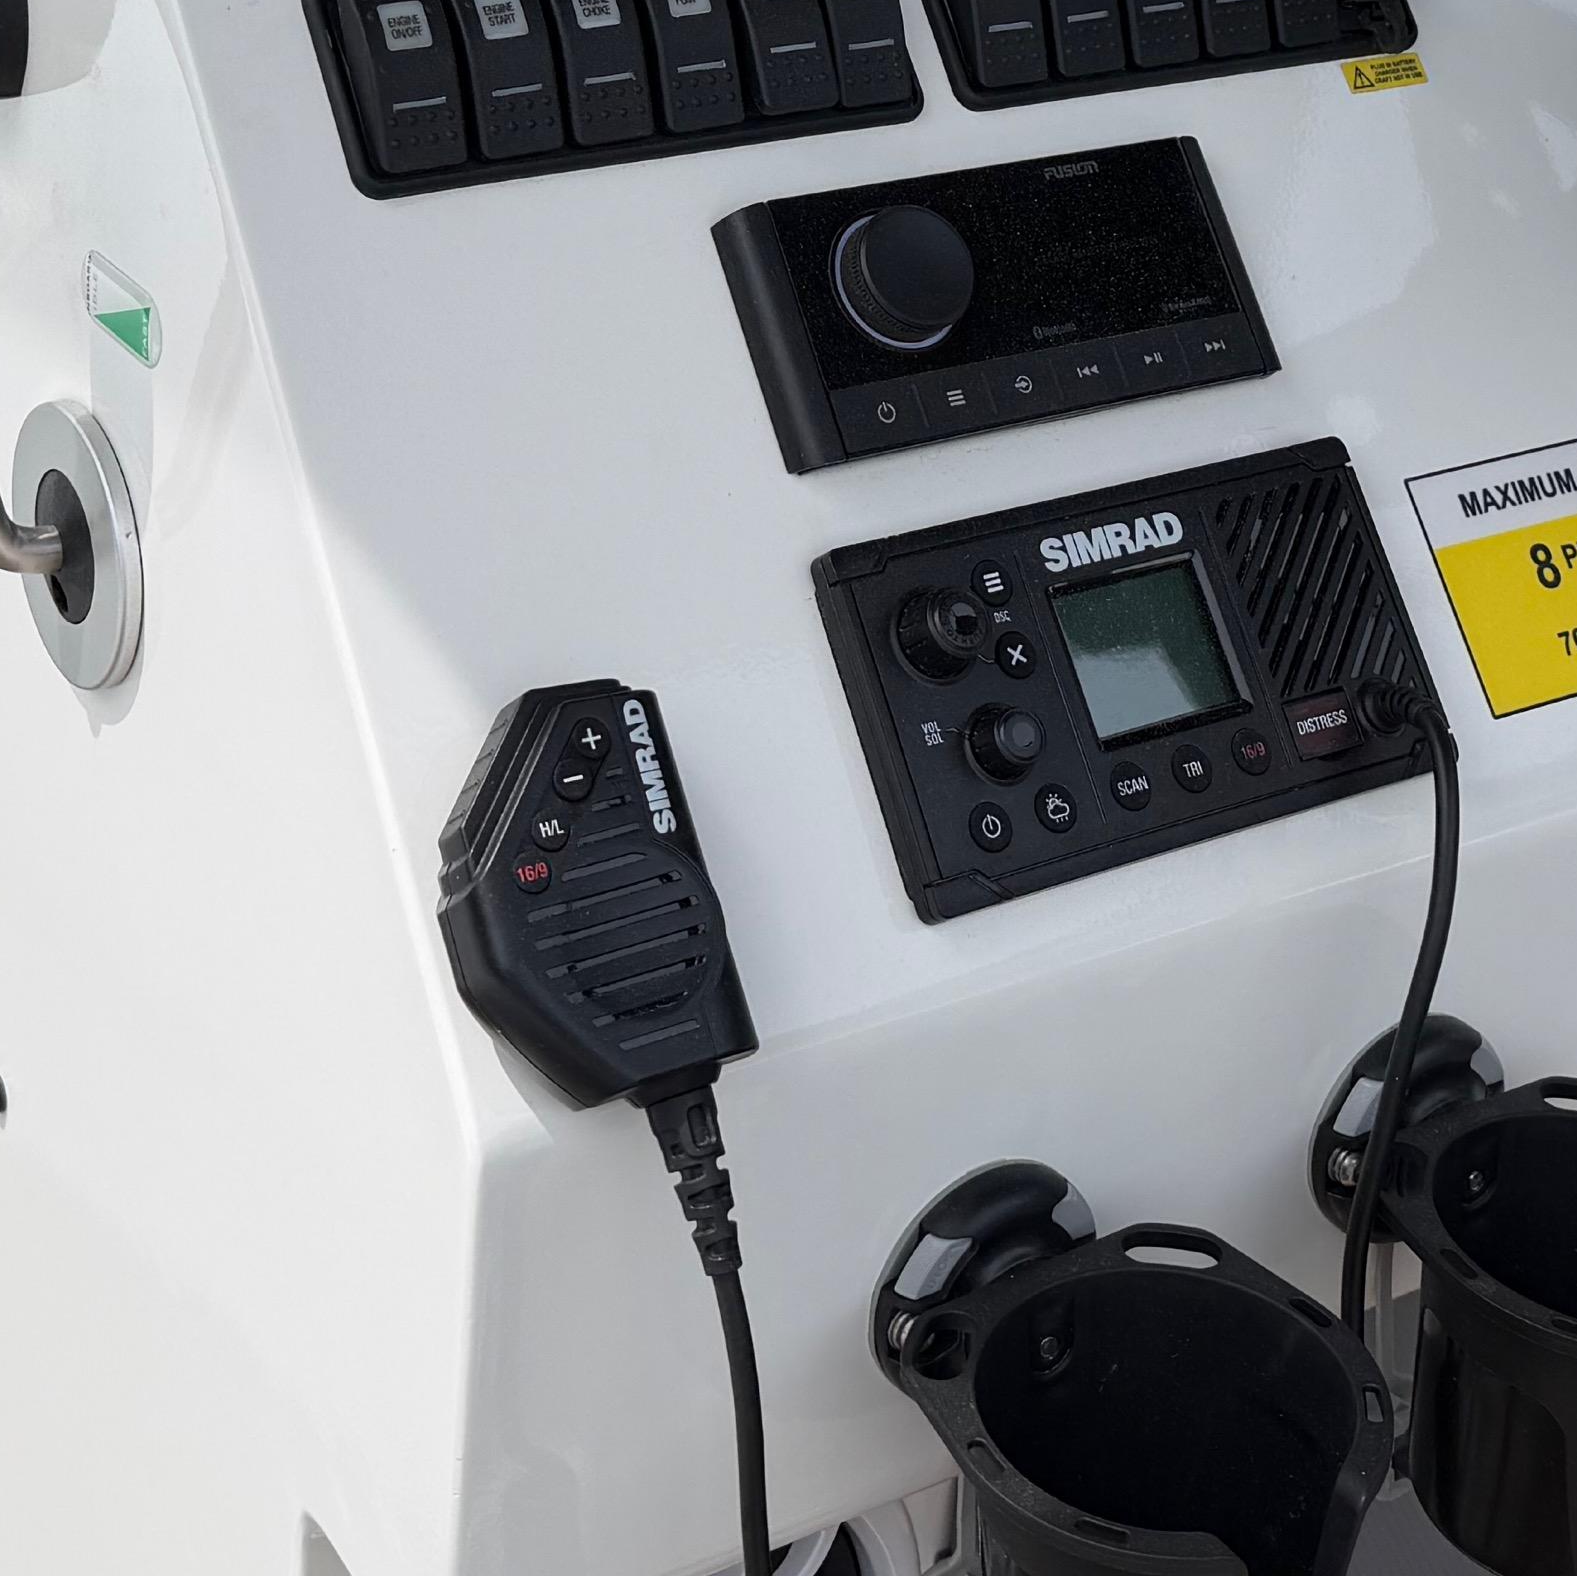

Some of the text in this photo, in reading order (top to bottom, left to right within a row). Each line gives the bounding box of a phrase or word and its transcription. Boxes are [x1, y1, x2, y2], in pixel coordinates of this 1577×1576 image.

[482, 1, 514, 16] ENGINE
[387, 13, 420, 28] ENGINE
[487, 12, 516, 27] START
[1044, 160, 1099, 181] FUSION
[1039, 510, 1185, 573] SIMRAD
[1529, 542, 1562, 589] 8
[994, 611, 1011, 623] DSC
[921, 721, 941, 735] VOL
[1297, 708, 1348, 736] DISTRESS
[1240, 741, 1266, 760] 16/9
[623, 698, 677, 835] SIMRAD
[1183, 760, 1204, 778] TRI
[1117, 775, 1149, 797] SCAN
[539, 819, 565, 838] H/L
[516, 862, 549, 883] 16/9
